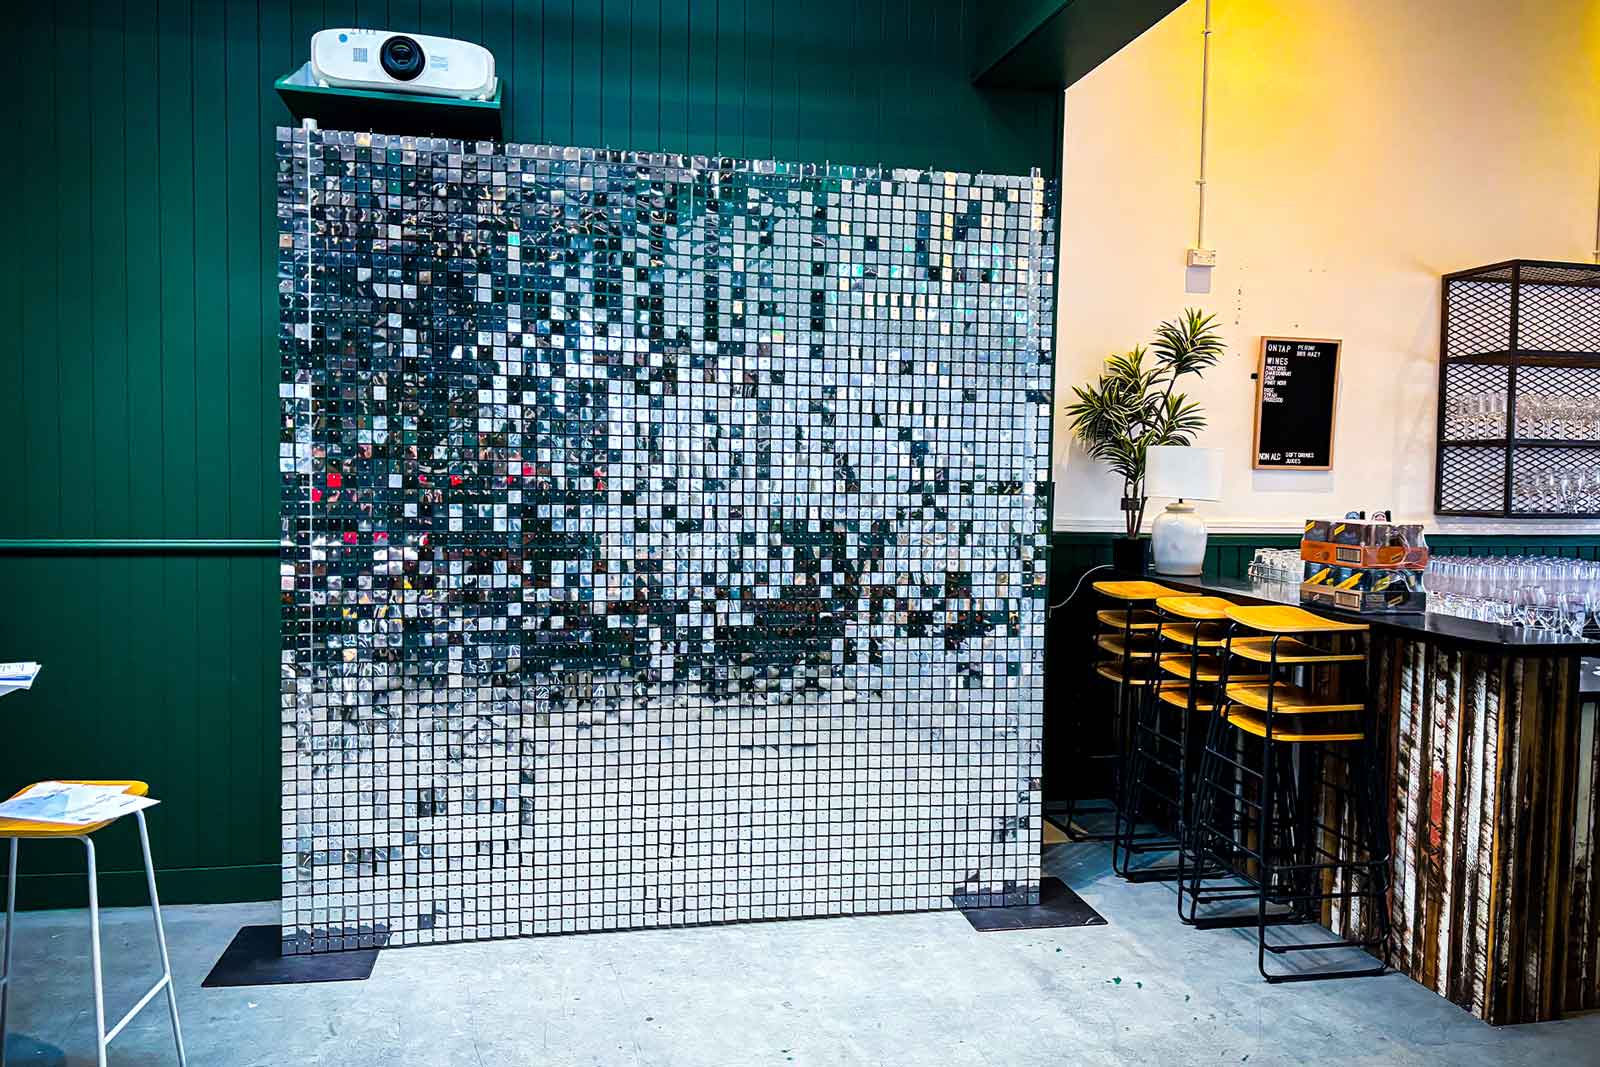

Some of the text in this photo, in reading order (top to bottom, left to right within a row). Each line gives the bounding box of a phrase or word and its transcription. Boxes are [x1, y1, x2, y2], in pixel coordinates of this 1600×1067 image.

[1268, 344, 1291, 353] ON TAP
[1267, 357, 1289, 365] WINES
[1259, 452, 1282, 461] NON ALC
